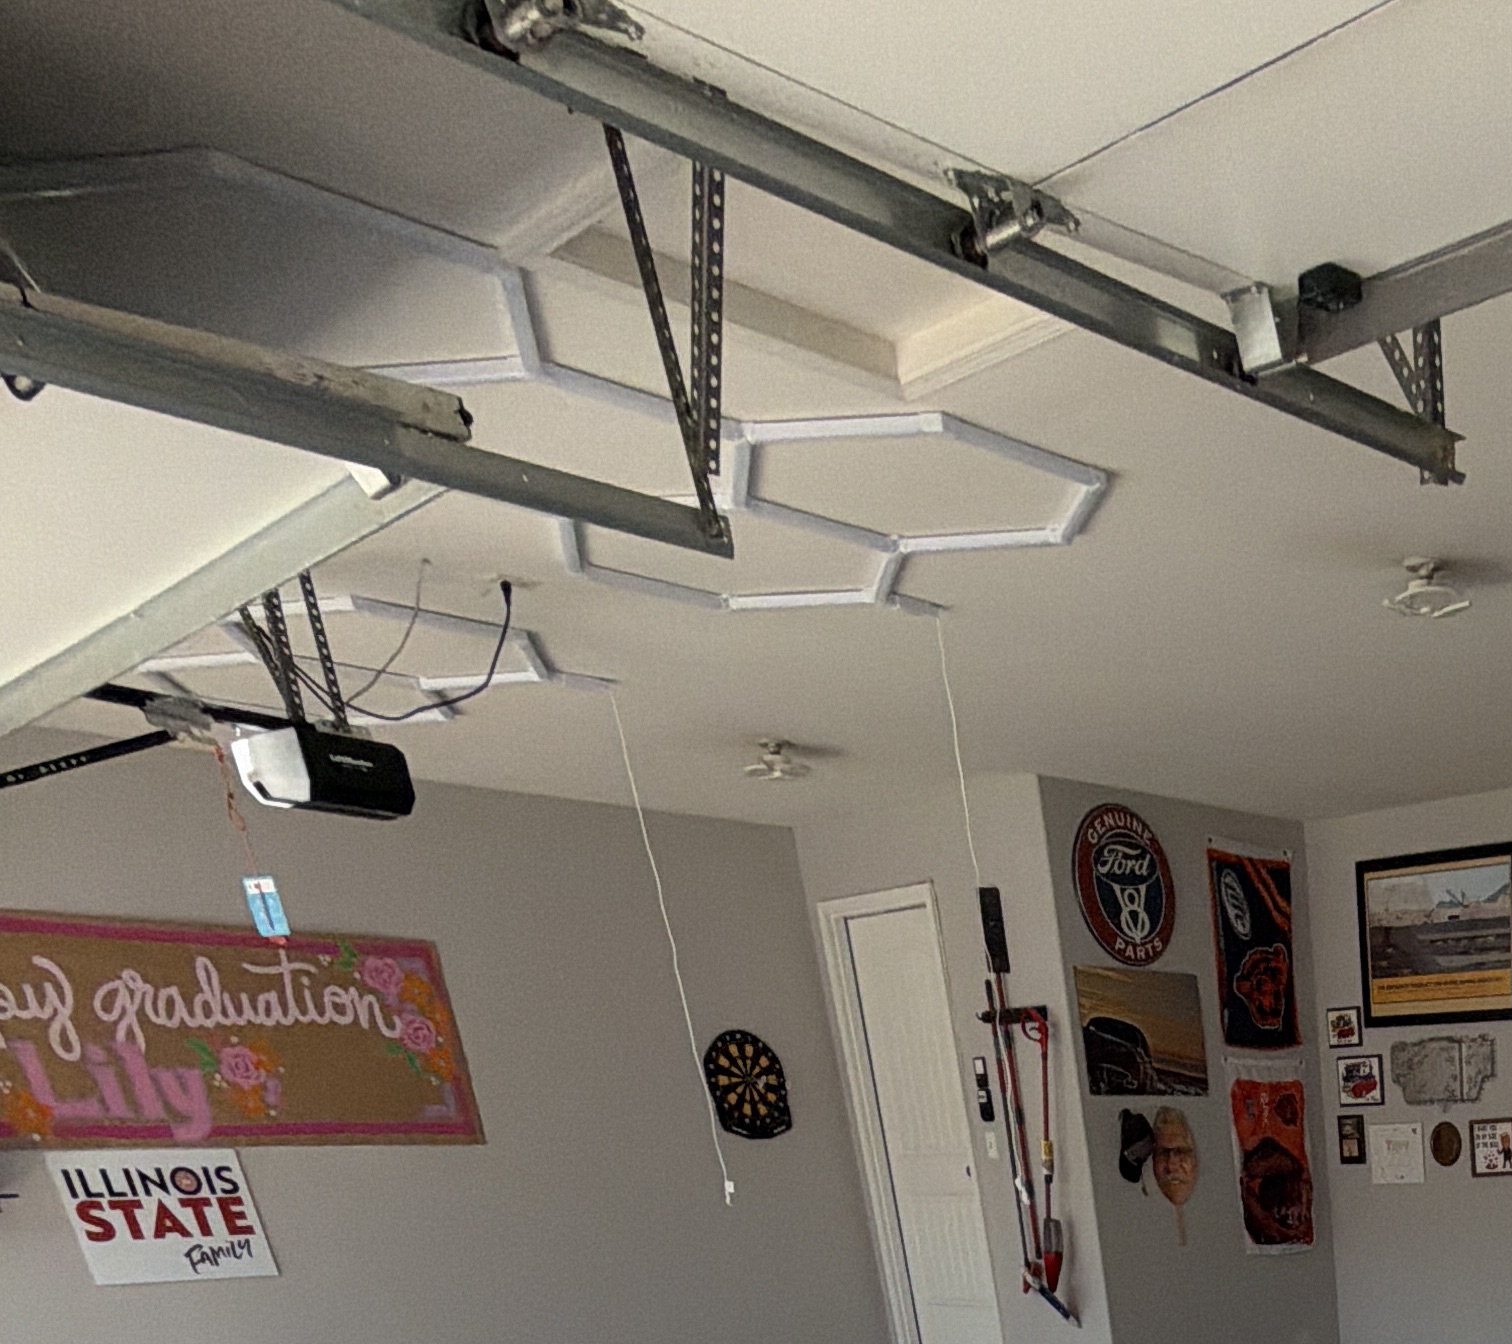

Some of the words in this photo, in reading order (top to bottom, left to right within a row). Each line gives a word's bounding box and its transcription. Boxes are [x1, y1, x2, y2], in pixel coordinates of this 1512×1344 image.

[1087, 811, 1153, 845] GENUINE
[1096, 844, 1152, 877] Ford
[1115, 936, 1163, 960] PARTS
[93, 945, 403, 1054] graduation
[7, 1038, 213, 1143] Lily
[61, 1165, 241, 1199] ILLINOIS
[75, 1196, 256, 1242] STATE
